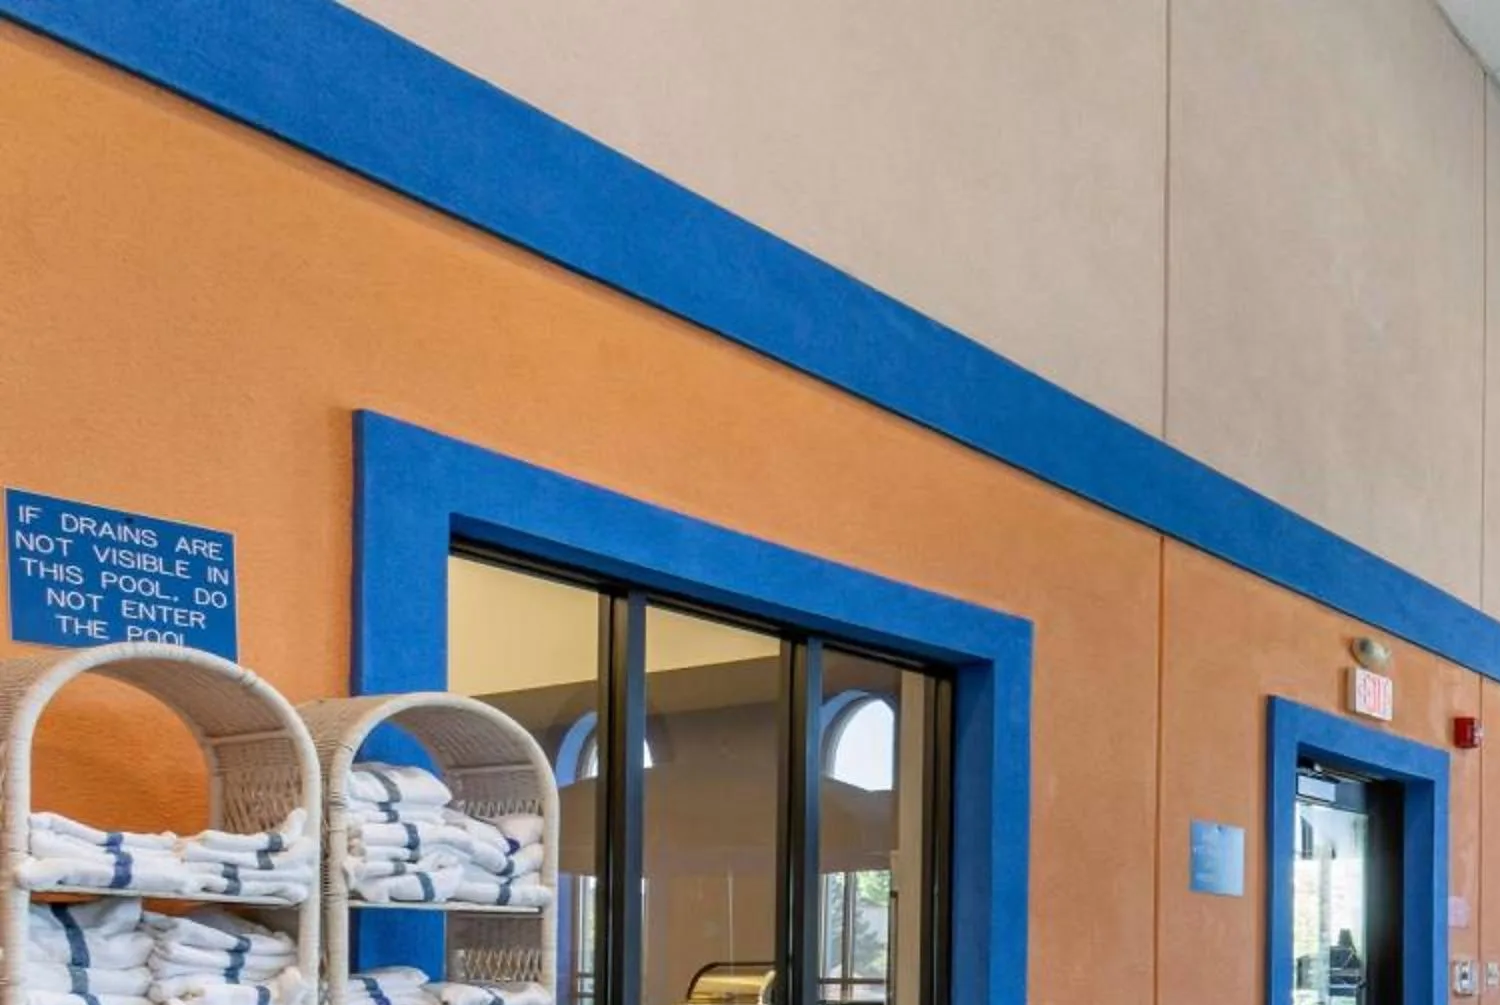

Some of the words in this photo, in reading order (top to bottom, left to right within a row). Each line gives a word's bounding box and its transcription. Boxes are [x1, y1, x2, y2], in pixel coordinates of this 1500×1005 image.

[15, 531, 73, 557] NOT
[93, 545, 191, 579] VISIBLE
[206, 567, 229, 586] IN
[18, 504, 42, 523] IF
[60, 513, 157, 548] DRAINS
[175, 536, 223, 561] ARE
[21, 557, 84, 584] THIS
[194, 588, 228, 609] DO
[47, 588, 103, 612] NOT
[121, 600, 206, 629] ENTER
[55, 614, 109, 640] THE
